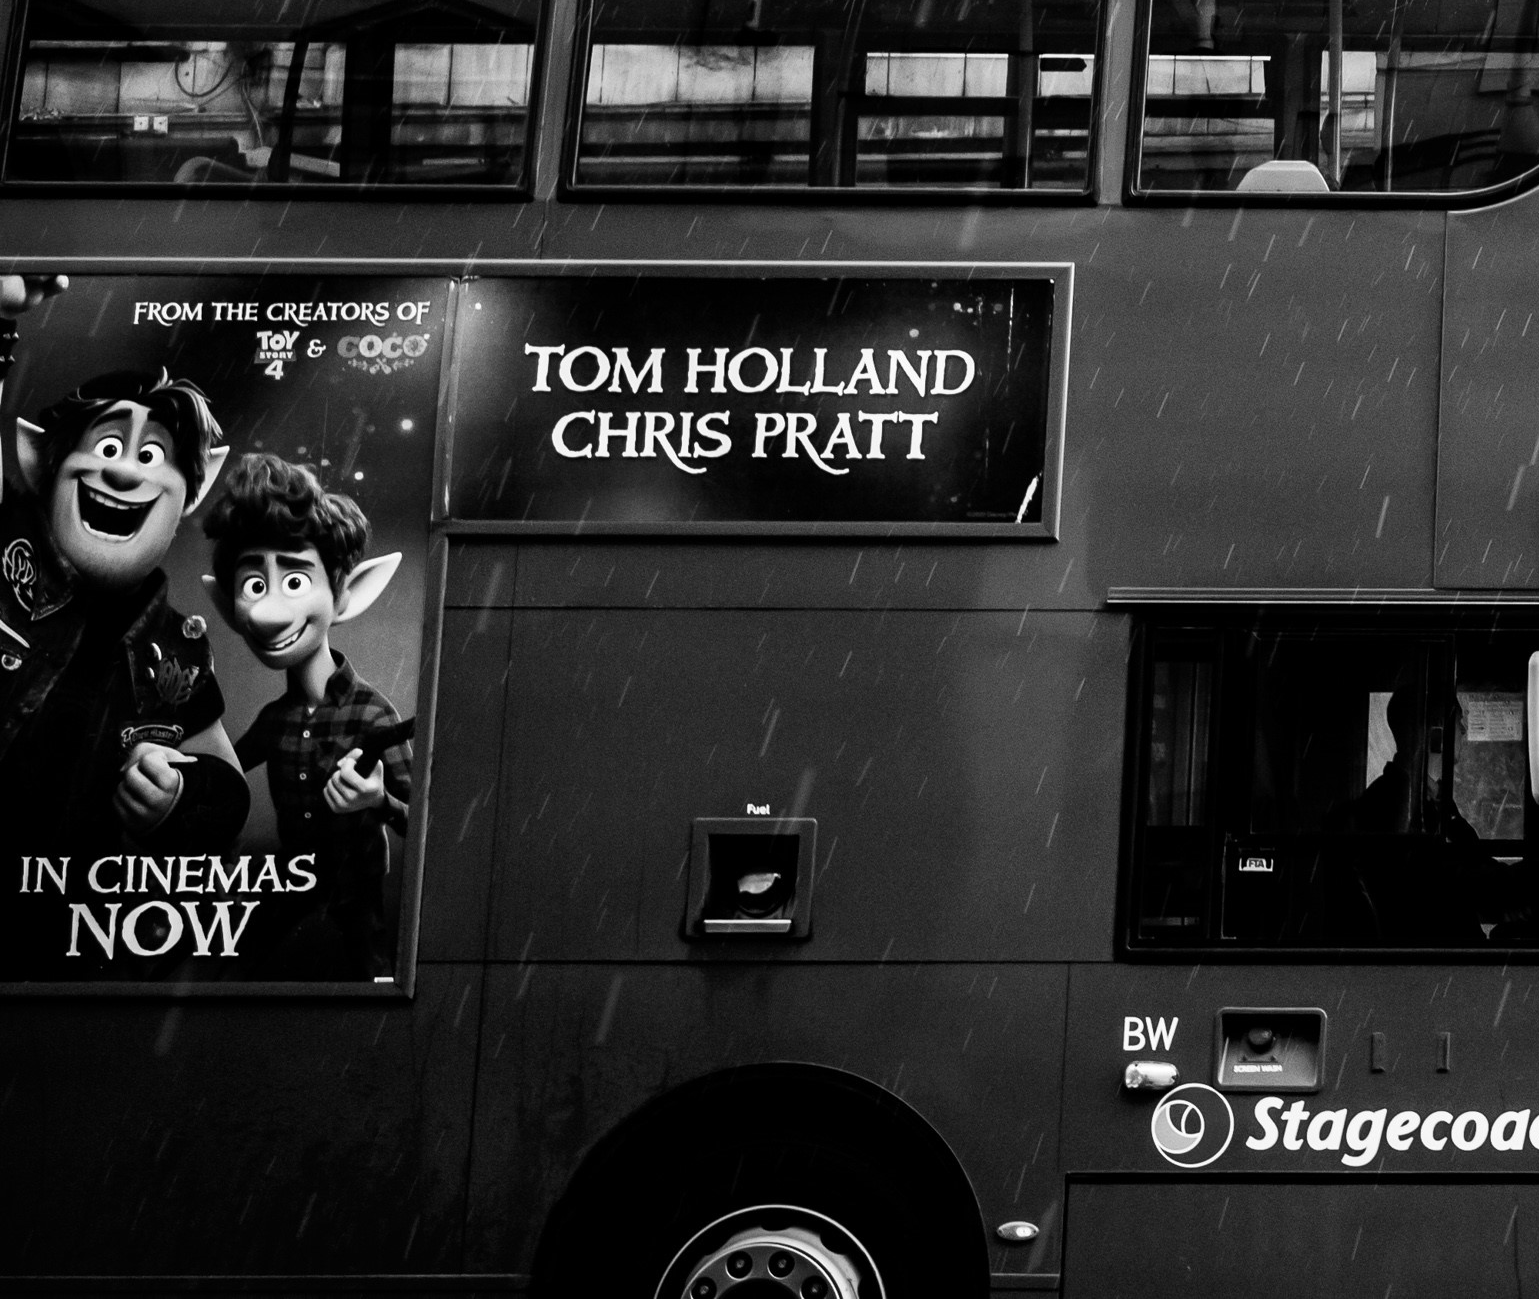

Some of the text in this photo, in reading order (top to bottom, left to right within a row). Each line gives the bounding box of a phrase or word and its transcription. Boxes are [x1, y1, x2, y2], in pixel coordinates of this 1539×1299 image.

[133, 301, 431, 327] FROM THE CREATORS OF
[256, 330, 429, 359] TOY & COCO
[264, 360, 284, 381] 4
[525, 342, 976, 398] TOM HOLLAND
[551, 408, 939, 476] CHRIS PRATT
[746, 803, 770, 816] Fuel
[19, 852, 318, 895] IN CINEMAS
[66, 899, 260, 960] NOW
[1122, 1016, 1179, 1052] BW
